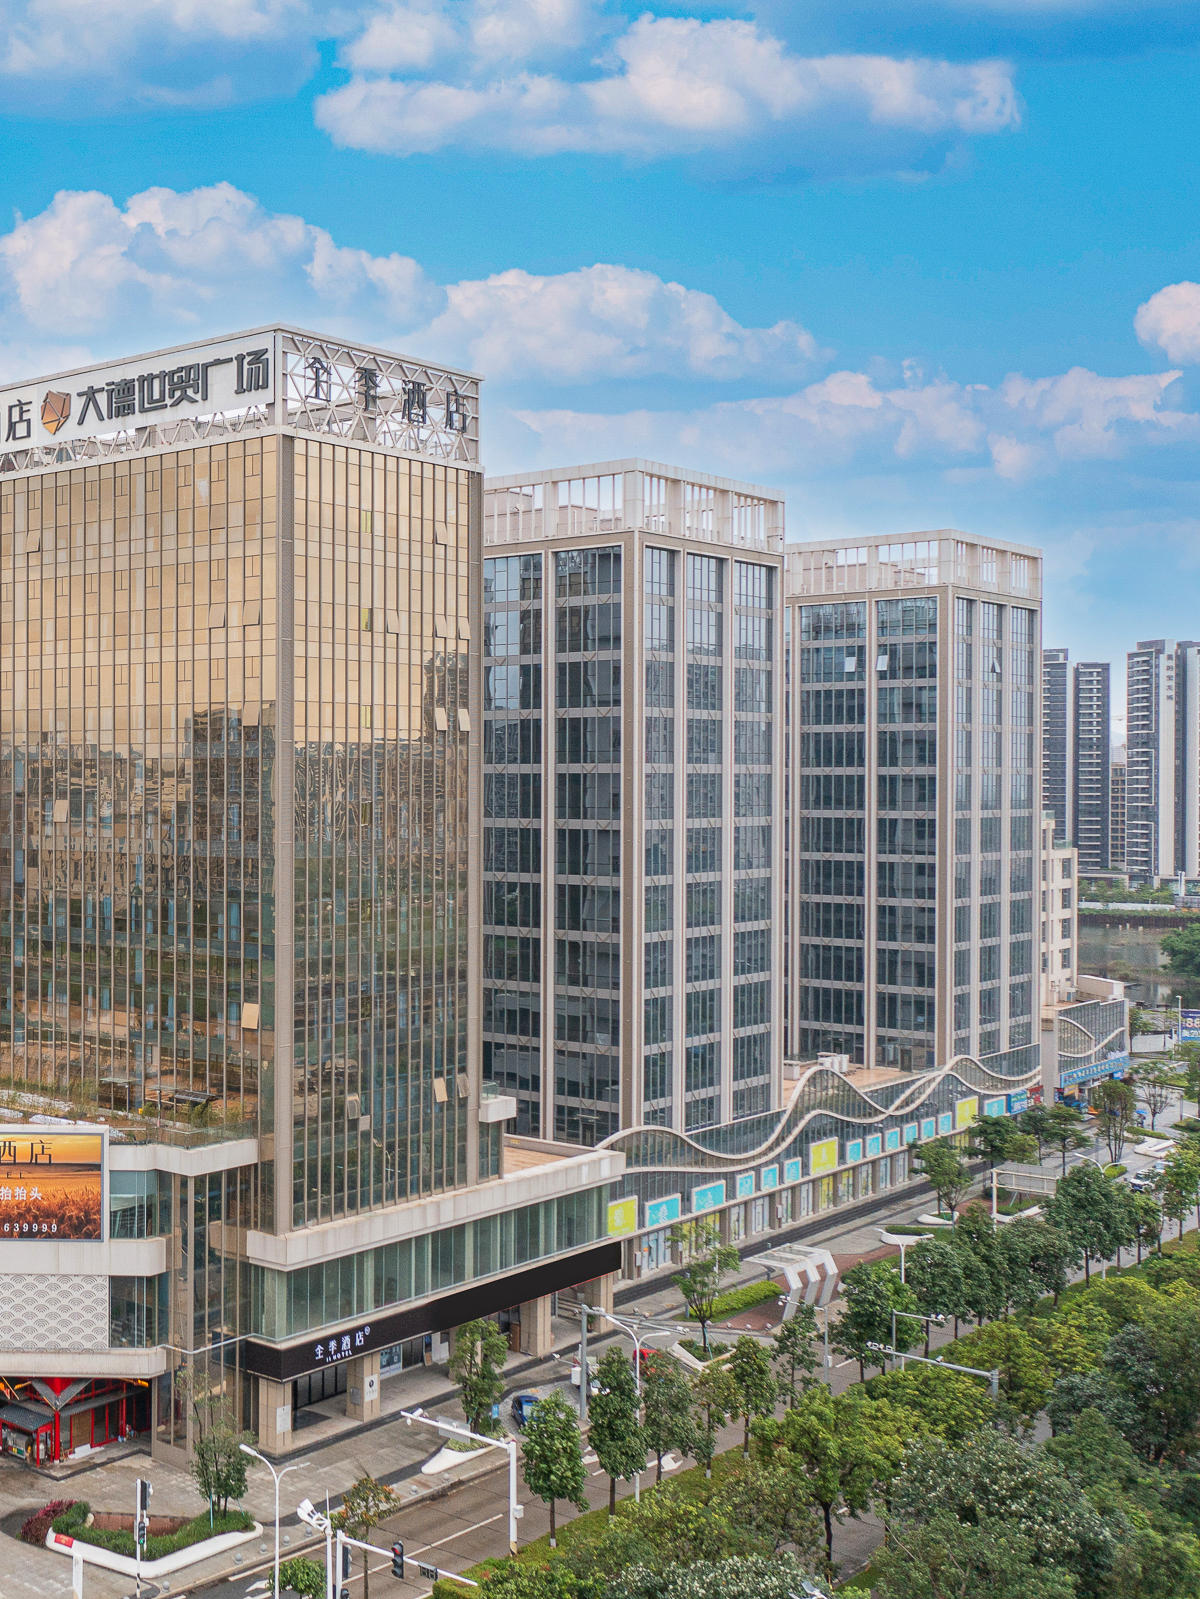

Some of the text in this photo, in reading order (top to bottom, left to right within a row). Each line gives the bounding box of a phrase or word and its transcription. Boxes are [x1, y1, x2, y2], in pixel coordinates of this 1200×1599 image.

[76, 347, 270, 426] 大德世贸广场
[303, 356, 468, 434] 全季酒店
[315, 1330, 364, 1360] 全季酒店
[332, 1349, 353, 1361] HOTEL
